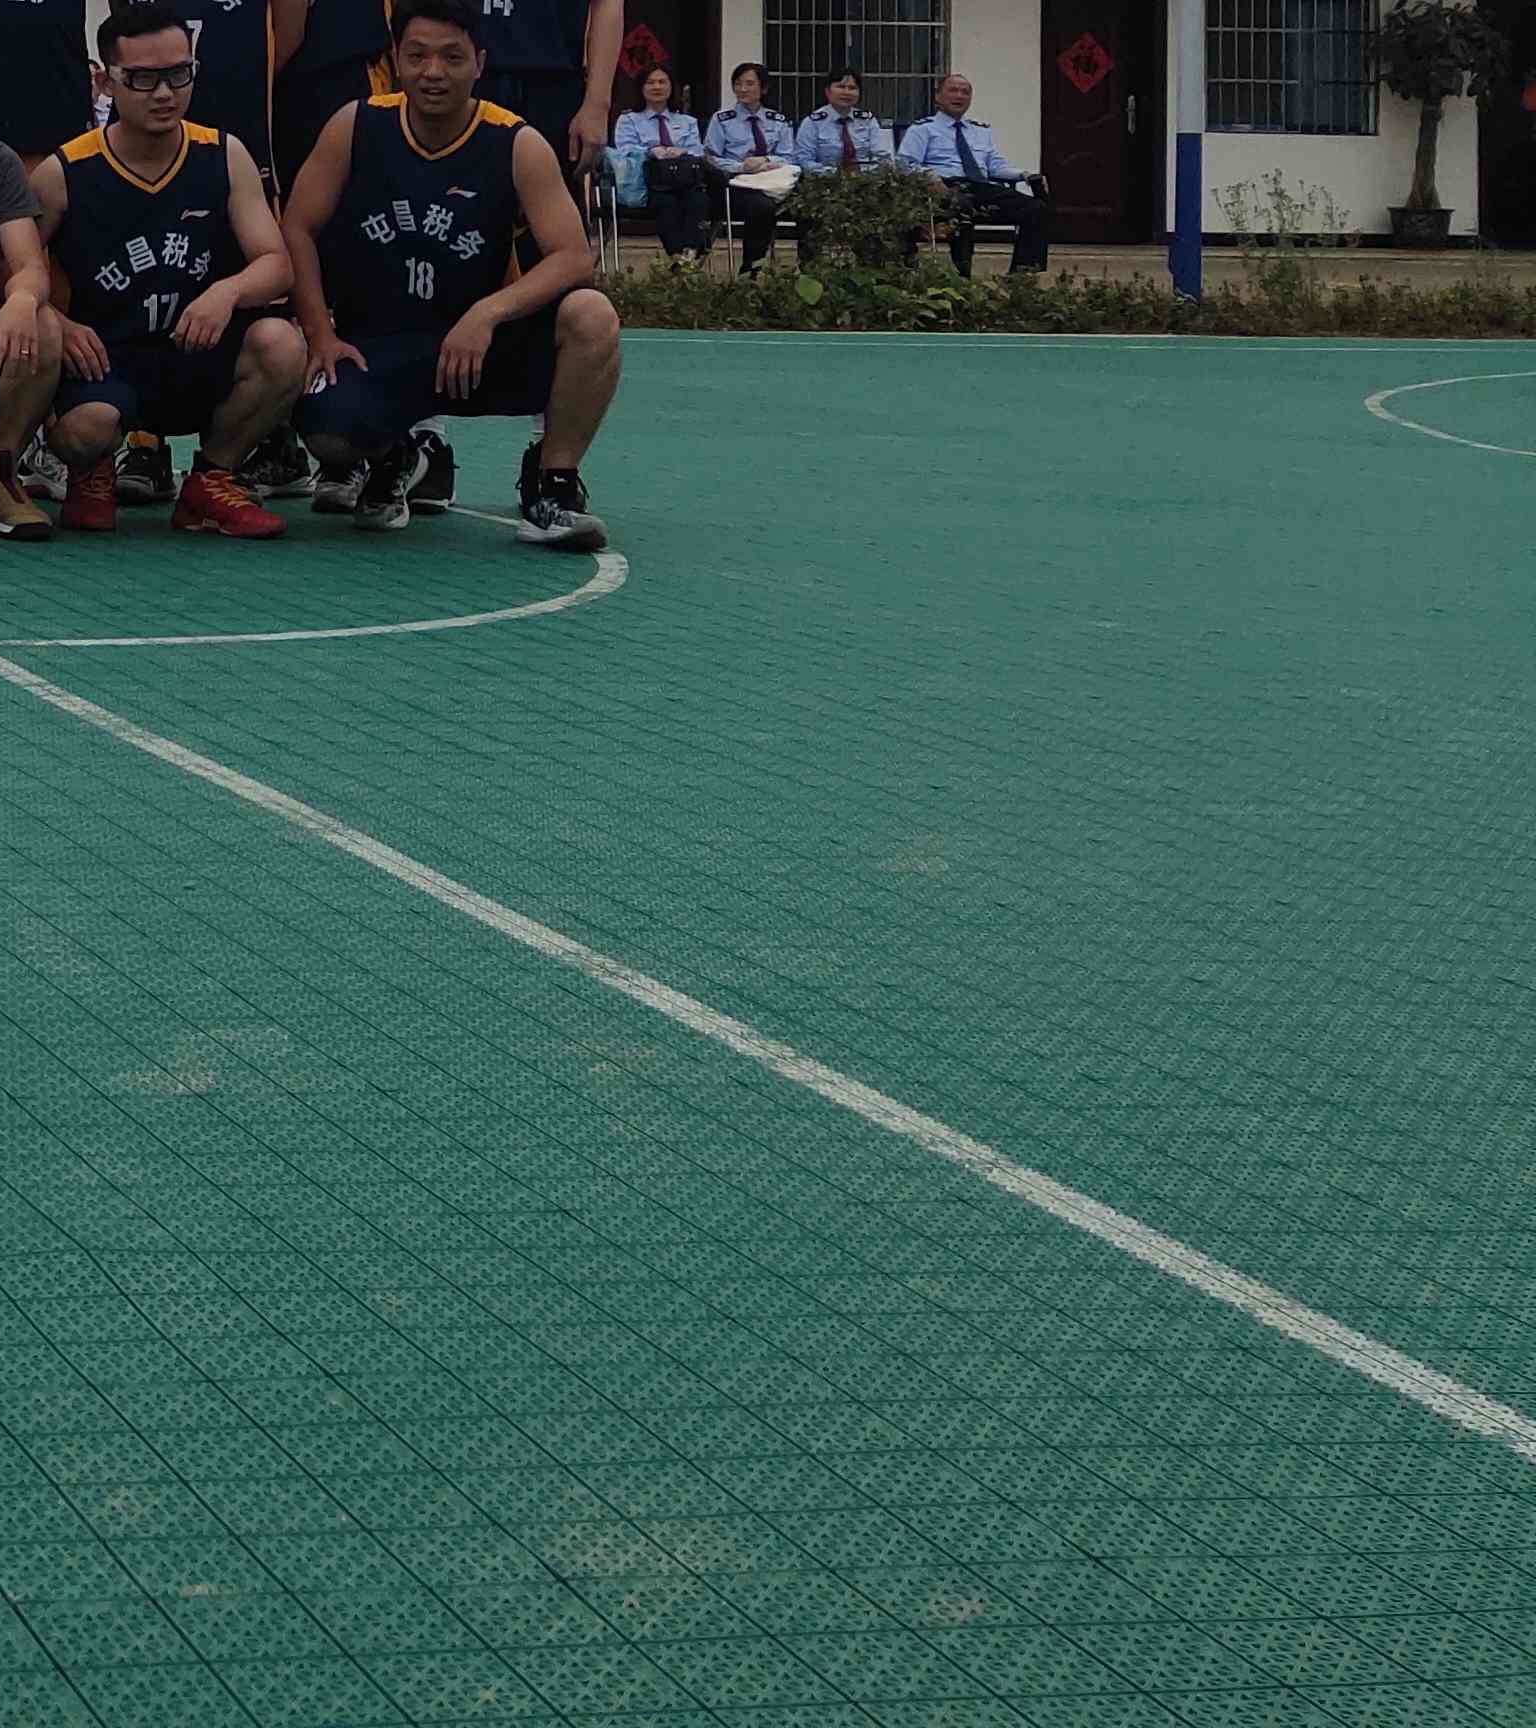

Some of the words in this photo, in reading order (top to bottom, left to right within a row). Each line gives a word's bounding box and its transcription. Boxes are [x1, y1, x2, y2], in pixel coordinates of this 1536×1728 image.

[360, 198, 488, 261] 屯昌税务
[93, 231, 213, 292] 屯昌税务
[405, 256, 436, 301] 18
[142, 291, 180, 332] 17
